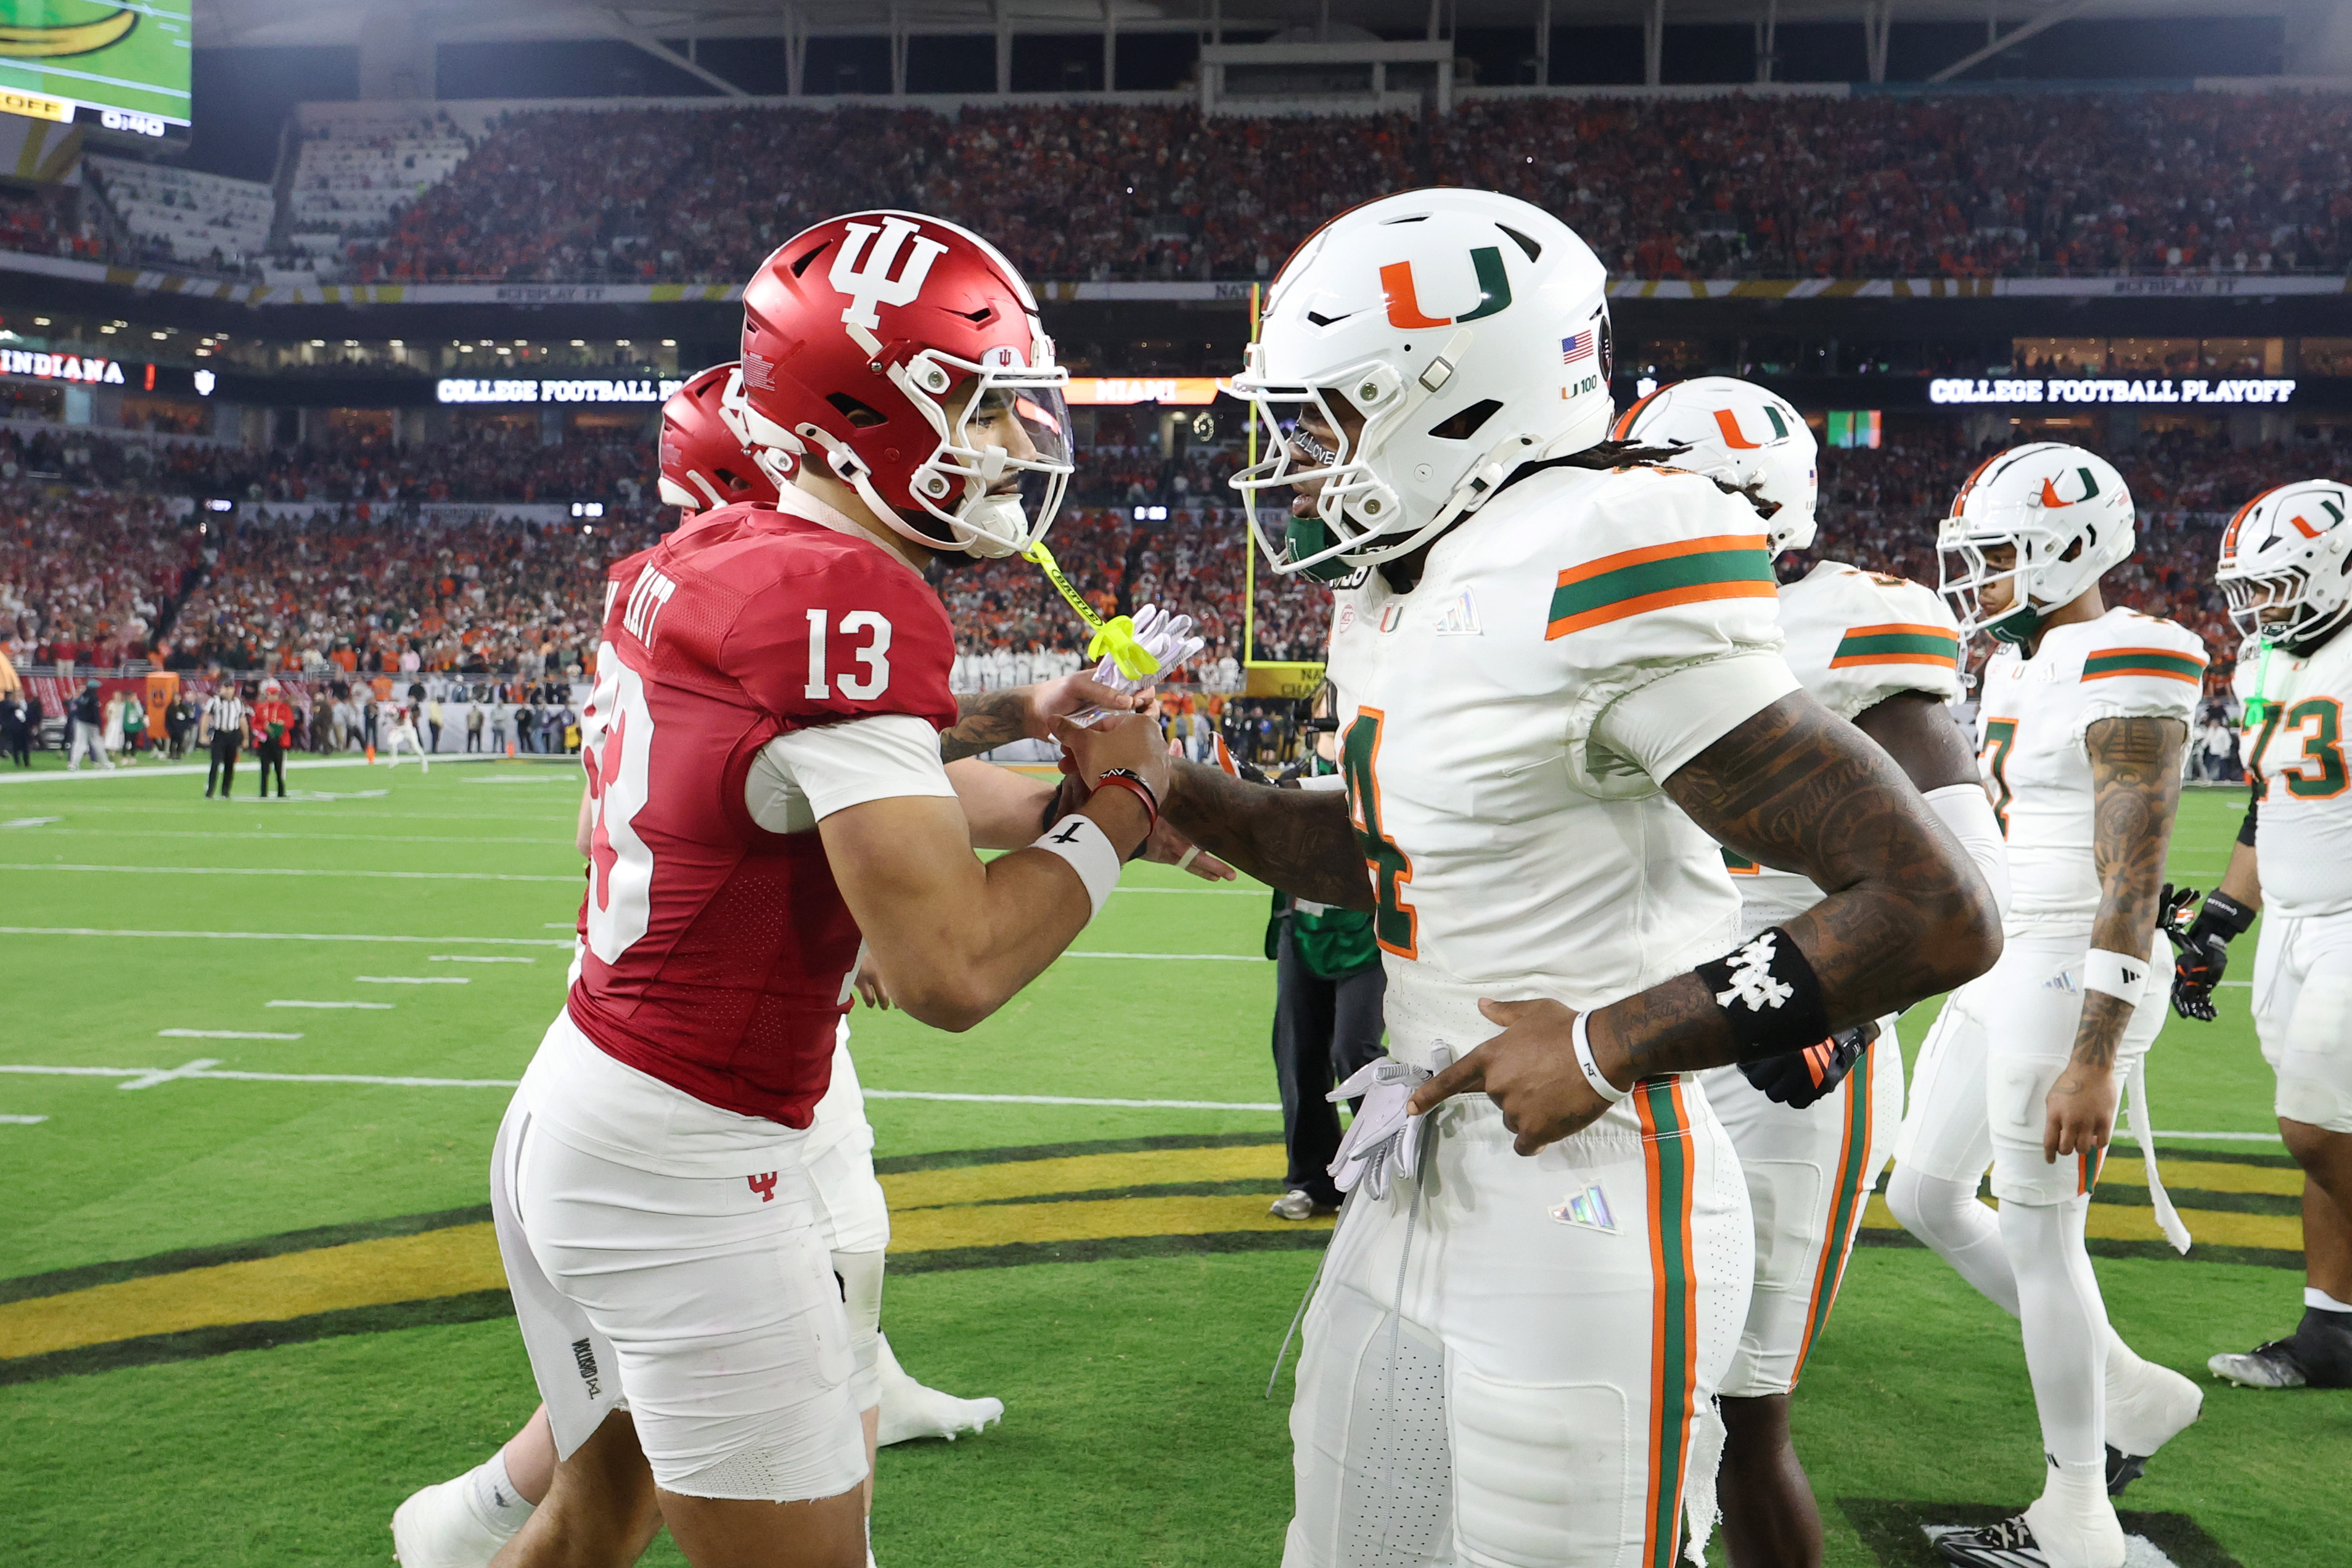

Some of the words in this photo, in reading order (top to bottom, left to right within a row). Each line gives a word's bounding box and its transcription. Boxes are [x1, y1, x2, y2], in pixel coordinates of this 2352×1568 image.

[1379, 247, 1512, 329] U
[0, 349, 125, 383] INDIANA
[1581, 374, 1597, 393] 100
[437, 379, 538, 402] COLLEGE
[541, 380, 657, 402] FOOTBALL
[1096, 380, 1176, 401] MIAMI
[1930, 378, 2043, 403] COLLEGE
[2047, 379, 2179, 402] FOOTBALL
[2181, 379, 2296, 402] PLAYOFF
[1713, 406, 1789, 449] U
[1056, 575, 1099, 621] BATTLE
[805, 610, 892, 700] 13
[2241, 696, 2350, 801] 73
[1979, 717, 2018, 841] 7
[1340, 705, 1417, 960] 4
